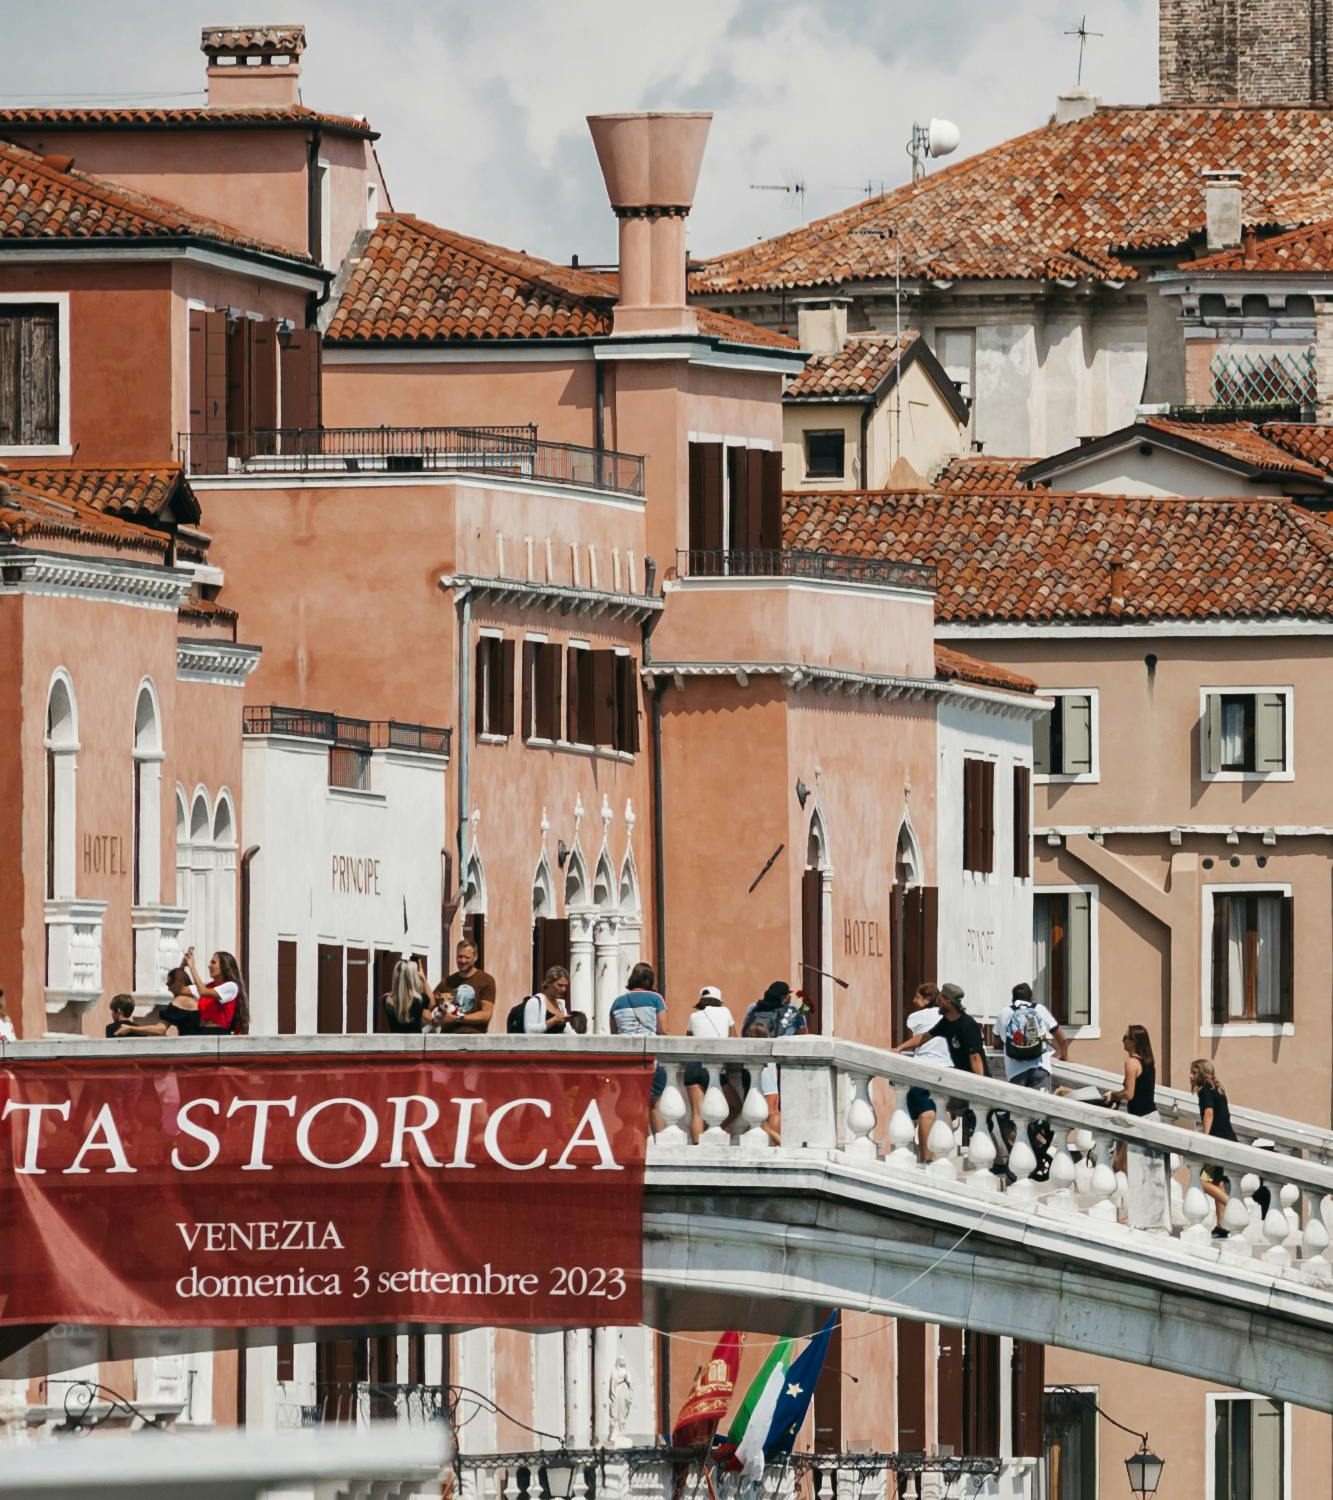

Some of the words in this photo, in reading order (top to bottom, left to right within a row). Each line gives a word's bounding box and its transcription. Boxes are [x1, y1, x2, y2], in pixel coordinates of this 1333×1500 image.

[83, 834, 127, 876] HOTEL
[331, 854, 381, 896] PRINCIPE
[843, 918, 884, 958] HOTEL
[0, 1100, 138, 1175] TA
[170, 1094, 625, 1173] STORICA
[175, 1220, 345, 1252] VENEZIA
[175, 1267, 342, 1299] domenica
[352, 1266, 370, 1299] 3
[377, 1263, 539, 1296] settembre
[548, 1267, 628, 1300] 2023
